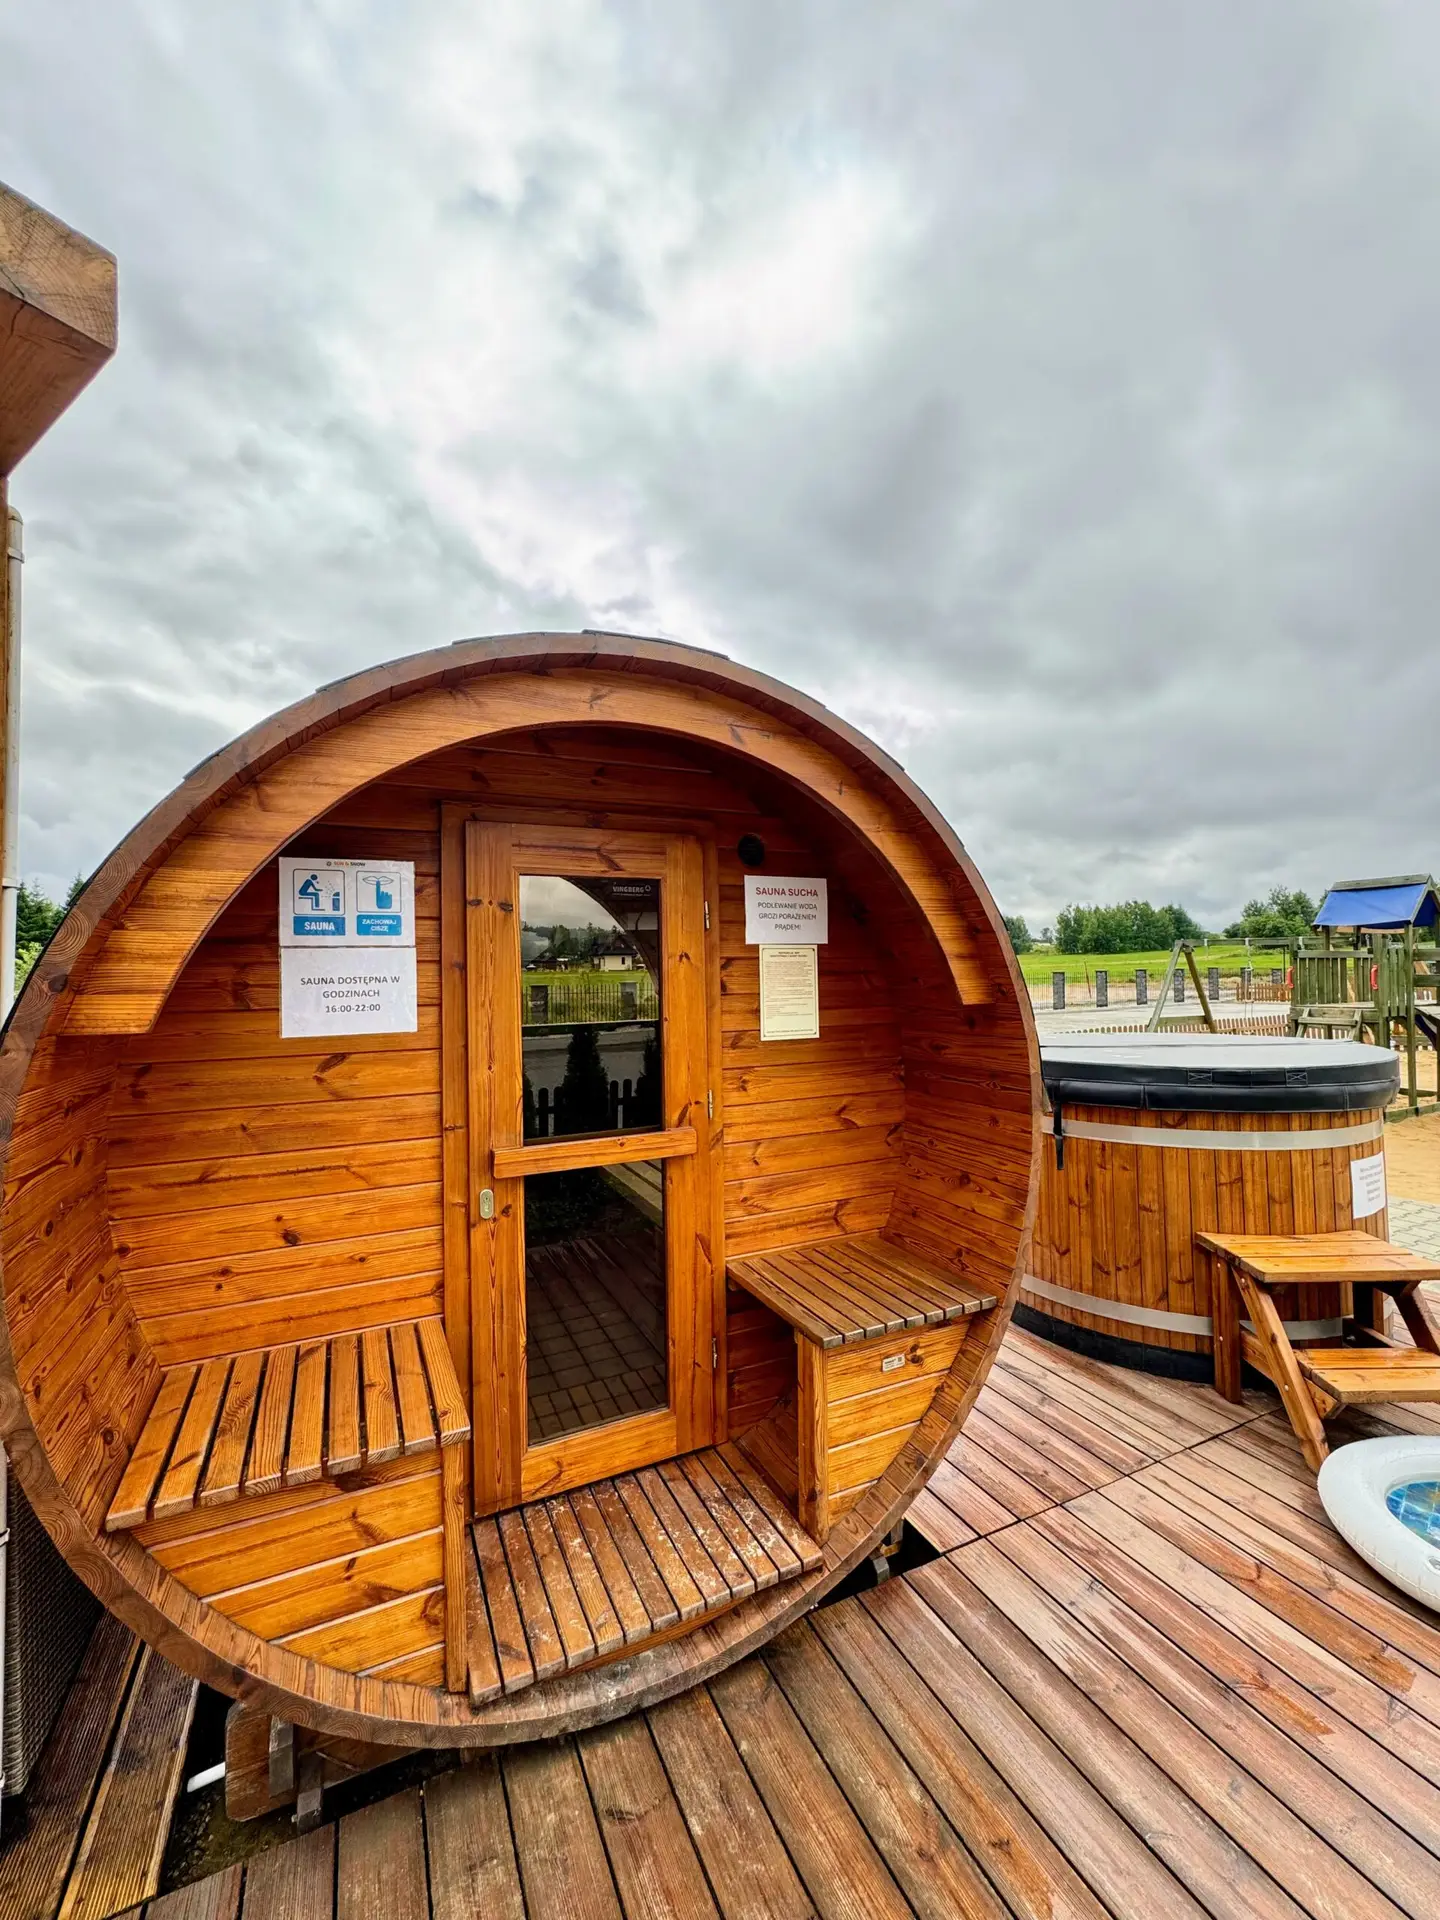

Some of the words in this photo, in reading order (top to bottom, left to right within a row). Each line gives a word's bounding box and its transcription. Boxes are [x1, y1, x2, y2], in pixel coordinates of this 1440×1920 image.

[755, 887, 787, 896] SAUNA
[788, 888, 819, 897] SUCHA
[757, 902, 798, 910] PODLEWANIE
[304, 921, 335, 931] SAUNA
[300, 977, 336, 986] SAUNA
[337, 976, 388, 986] DOSTĘPNA
[390, 976, 401, 984] W
[322, 989, 380, 999] GODZINACH
[325, 1003, 381, 1013] 16:00-22:00
